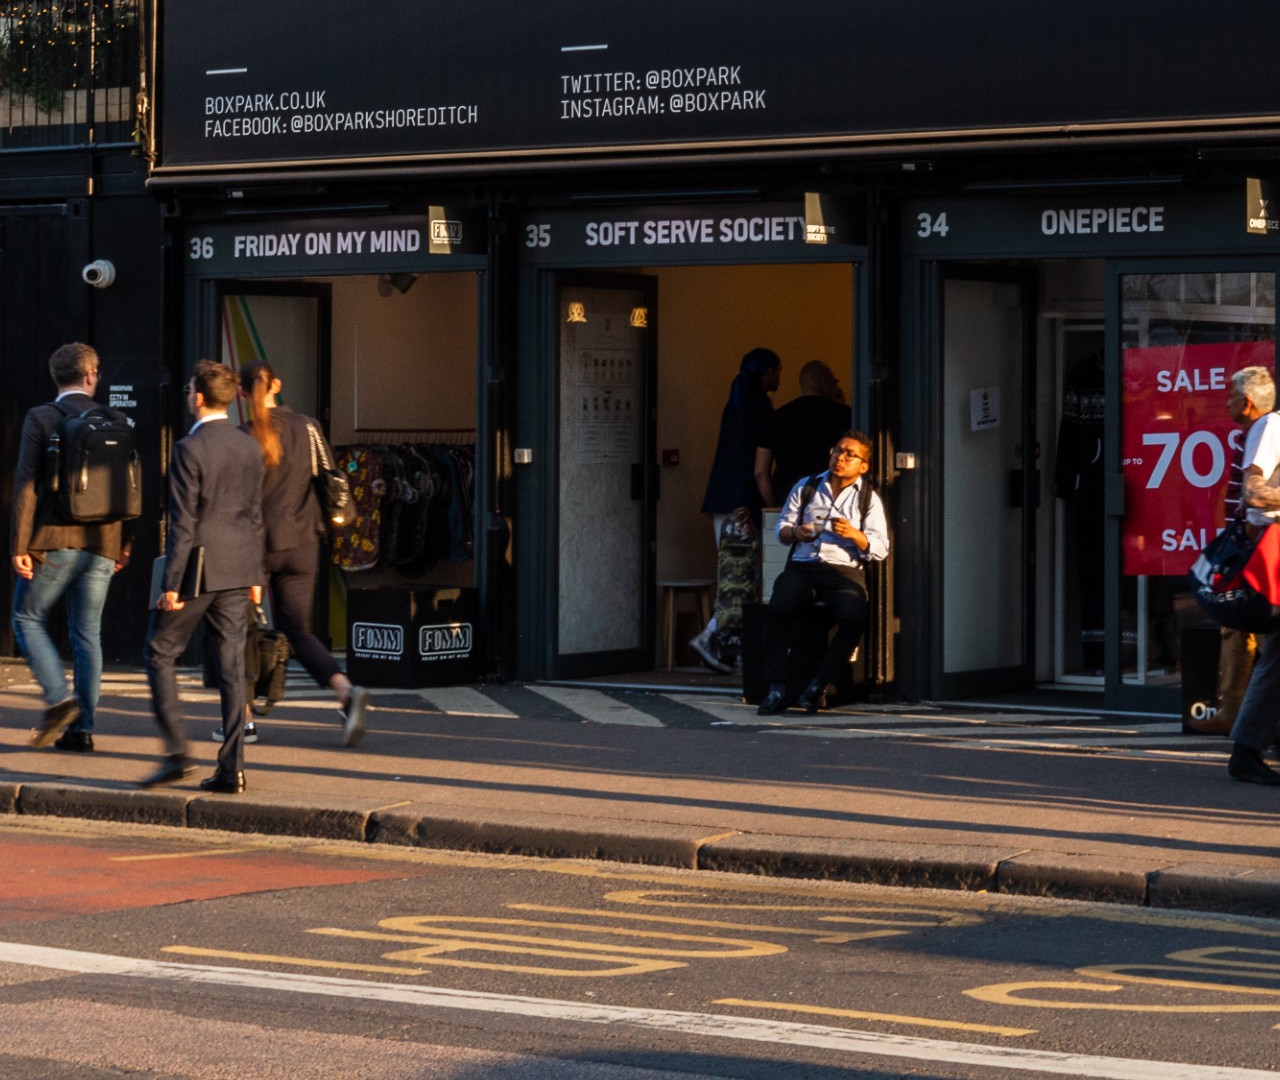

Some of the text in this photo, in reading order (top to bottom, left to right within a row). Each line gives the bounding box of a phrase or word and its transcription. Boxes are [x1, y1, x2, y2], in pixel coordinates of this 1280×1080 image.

[561, 66, 741, 94] TWITTER: @BOXPARK
[205, 91, 326, 115] BOXPARK.CO.UK
[561, 90, 766, 119] INSTAGRAM: @BOXPARK
[204, 105, 478, 138] FACEBOOK: @BOXPARKSHOREDITCH
[586, 221, 638, 246] SOFT
[643, 218, 715, 244] SERVE
[916, 212, 949, 238] 34
[1041, 206, 1164, 235] ONEPIECE
[190, 237, 214, 260] 36
[234, 229, 420, 257] FRIDAY ON MY MIND
[525, 223, 552, 248] 35
[1157, 367, 1226, 392] SALE
[1142, 429, 1244, 489] 70
